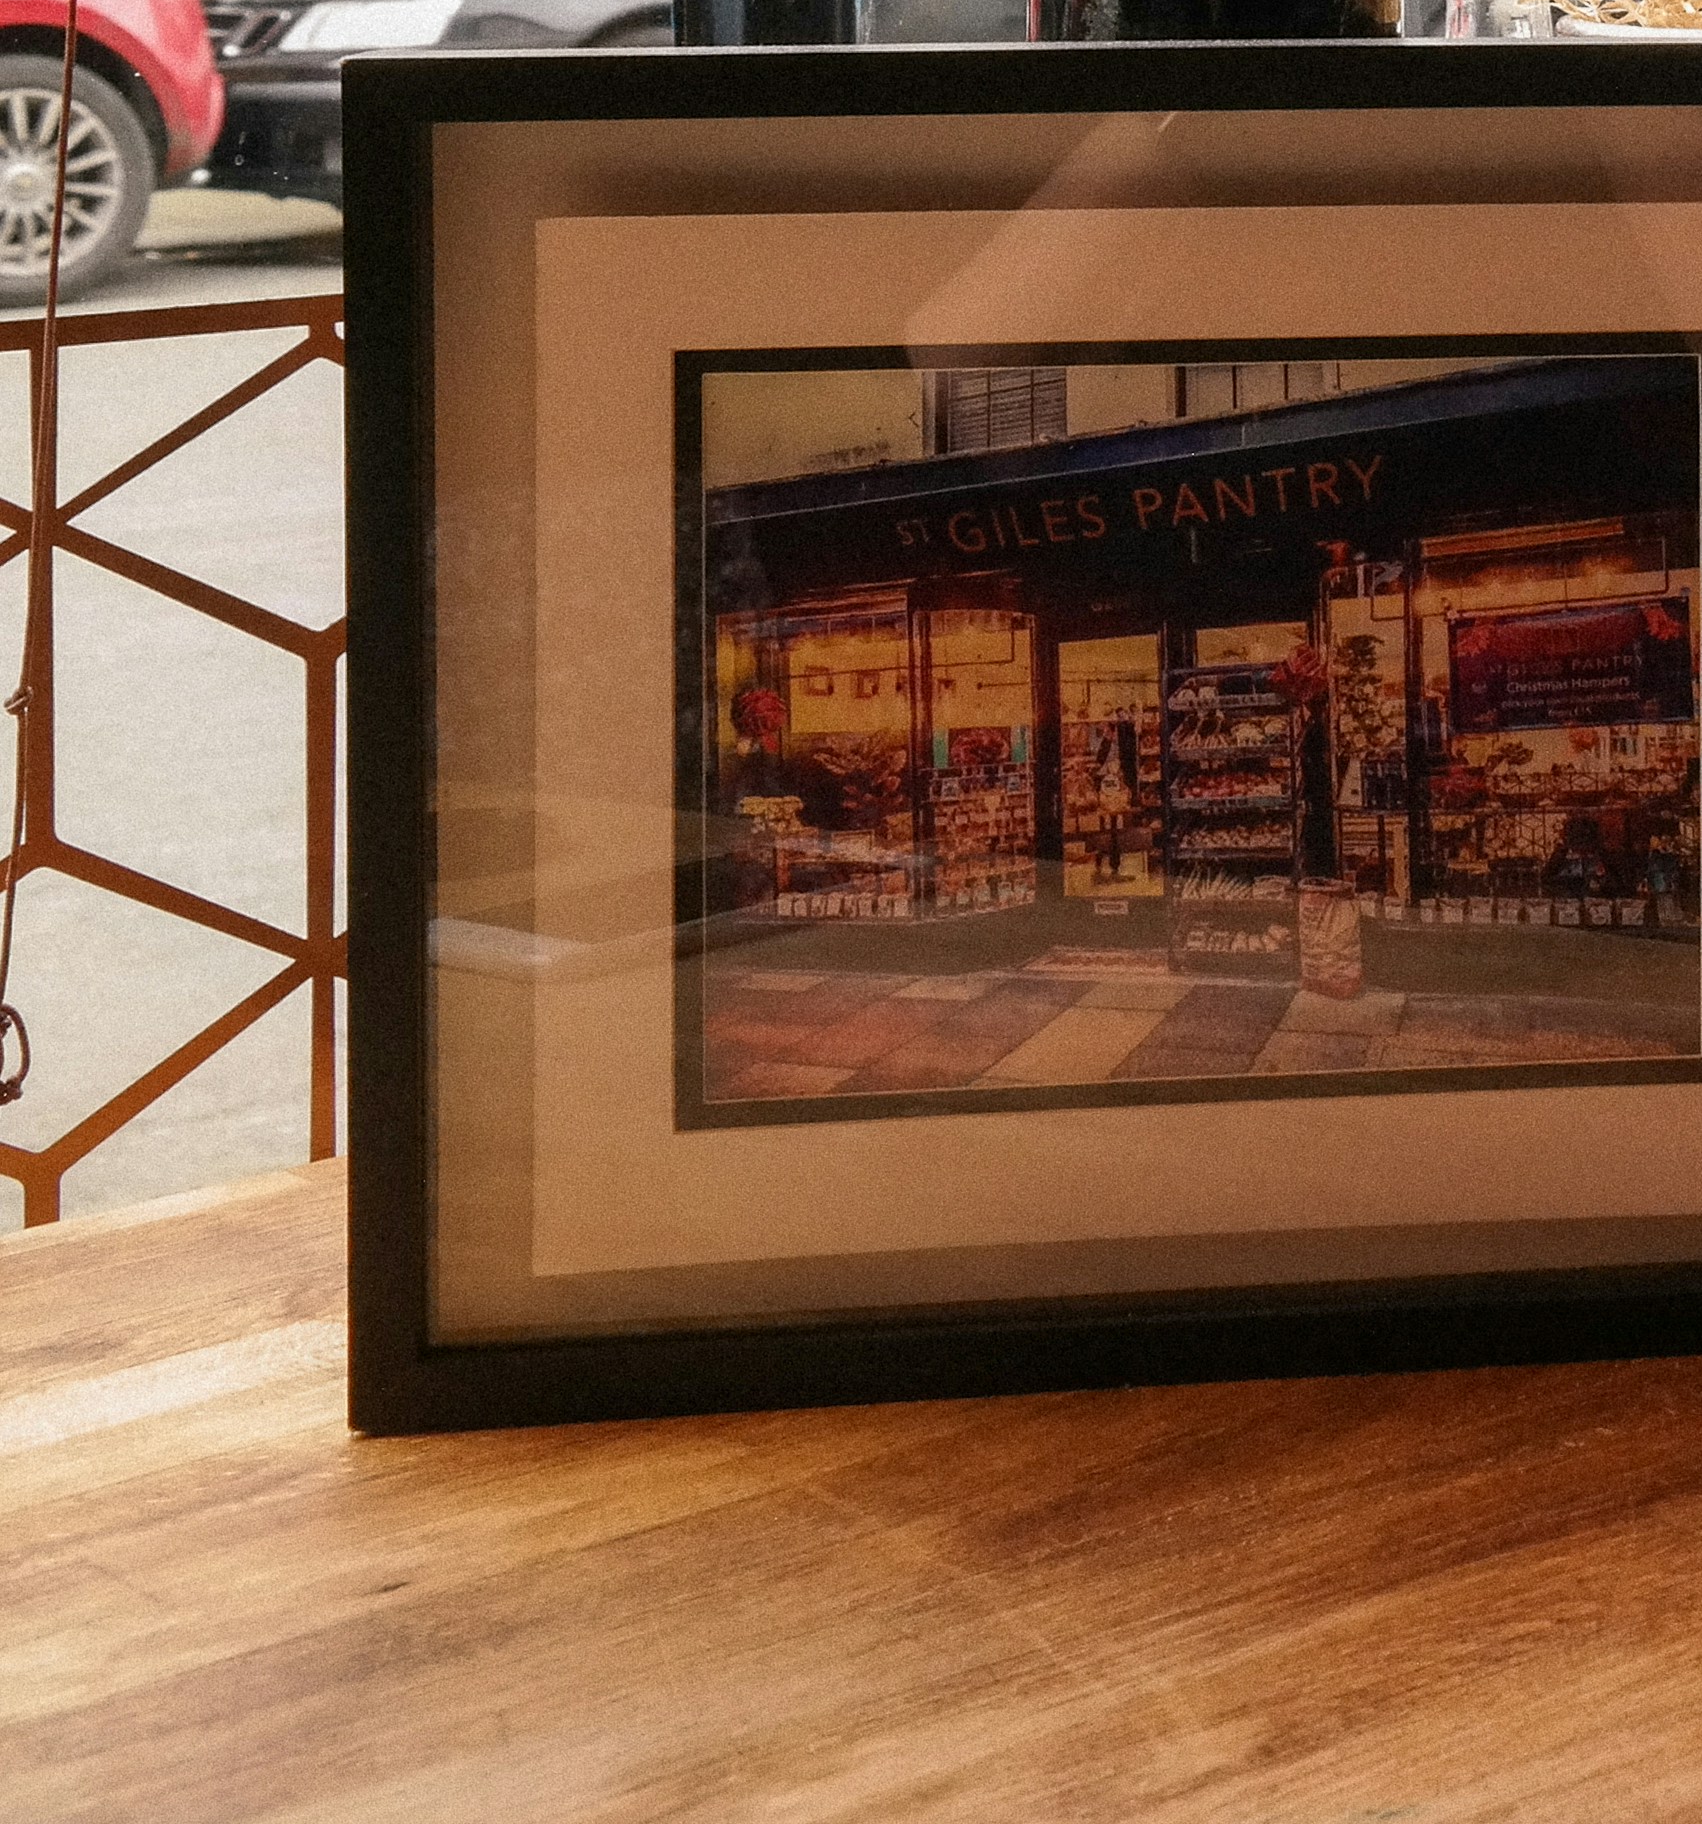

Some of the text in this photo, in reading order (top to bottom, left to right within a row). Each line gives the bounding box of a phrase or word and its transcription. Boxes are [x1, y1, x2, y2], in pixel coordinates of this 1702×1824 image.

[946, 495, 1107, 554] GILES
[1131, 454, 1384, 530] PANTRY
[1506, 676, 1631, 694] Christmas Hampers
